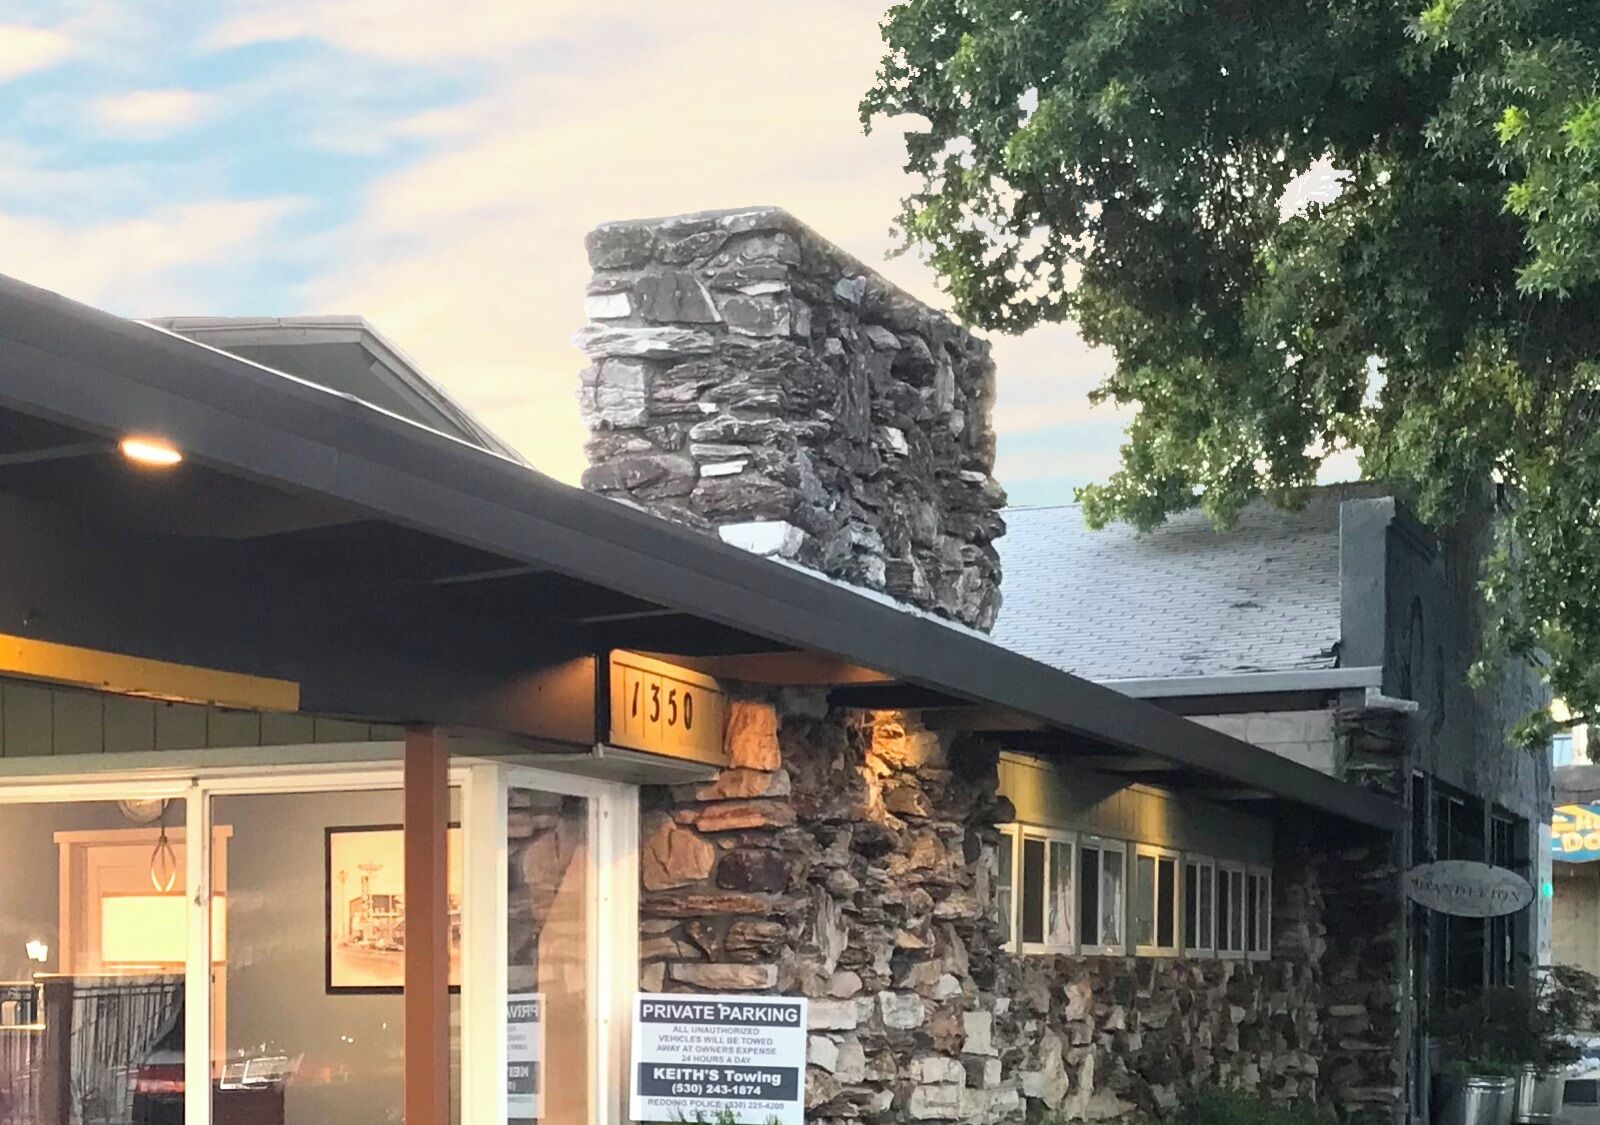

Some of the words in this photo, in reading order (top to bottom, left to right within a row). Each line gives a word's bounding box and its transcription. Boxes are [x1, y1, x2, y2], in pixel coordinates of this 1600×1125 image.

[631, 681, 693, 730] 1350
[642, 1003, 715, 1020] PRIVATE
[719, 1005, 798, 1022] PARKING
[672, 1025, 689, 1033] ALL
[691, 1026, 760, 1035] UNAUTHORIZED
[658, 1034, 702, 1043] VEHICLES
[703, 1036, 724, 1044] WILL
[741, 1037, 773, 1046] TOWED
[656, 1044, 681, 1052] AWAY
[682, 1045, 693, 1053] AT
[695, 1045, 734, 1054] OWNERS
[736, 1046, 777, 1055] EXPENSE
[681, 1054, 691, 1062] 24
[693, 1055, 725, 1063] HOURS
[734, 1056, 751, 1064] DAY
[653, 1067, 720, 1082] KEITH'S
[724, 1070, 782, 1085] Towing
[671, 1083, 703, 1096] (530)
[706, 1083, 762, 1096] 243-1874
[647, 1098, 688, 1106] REDDING
